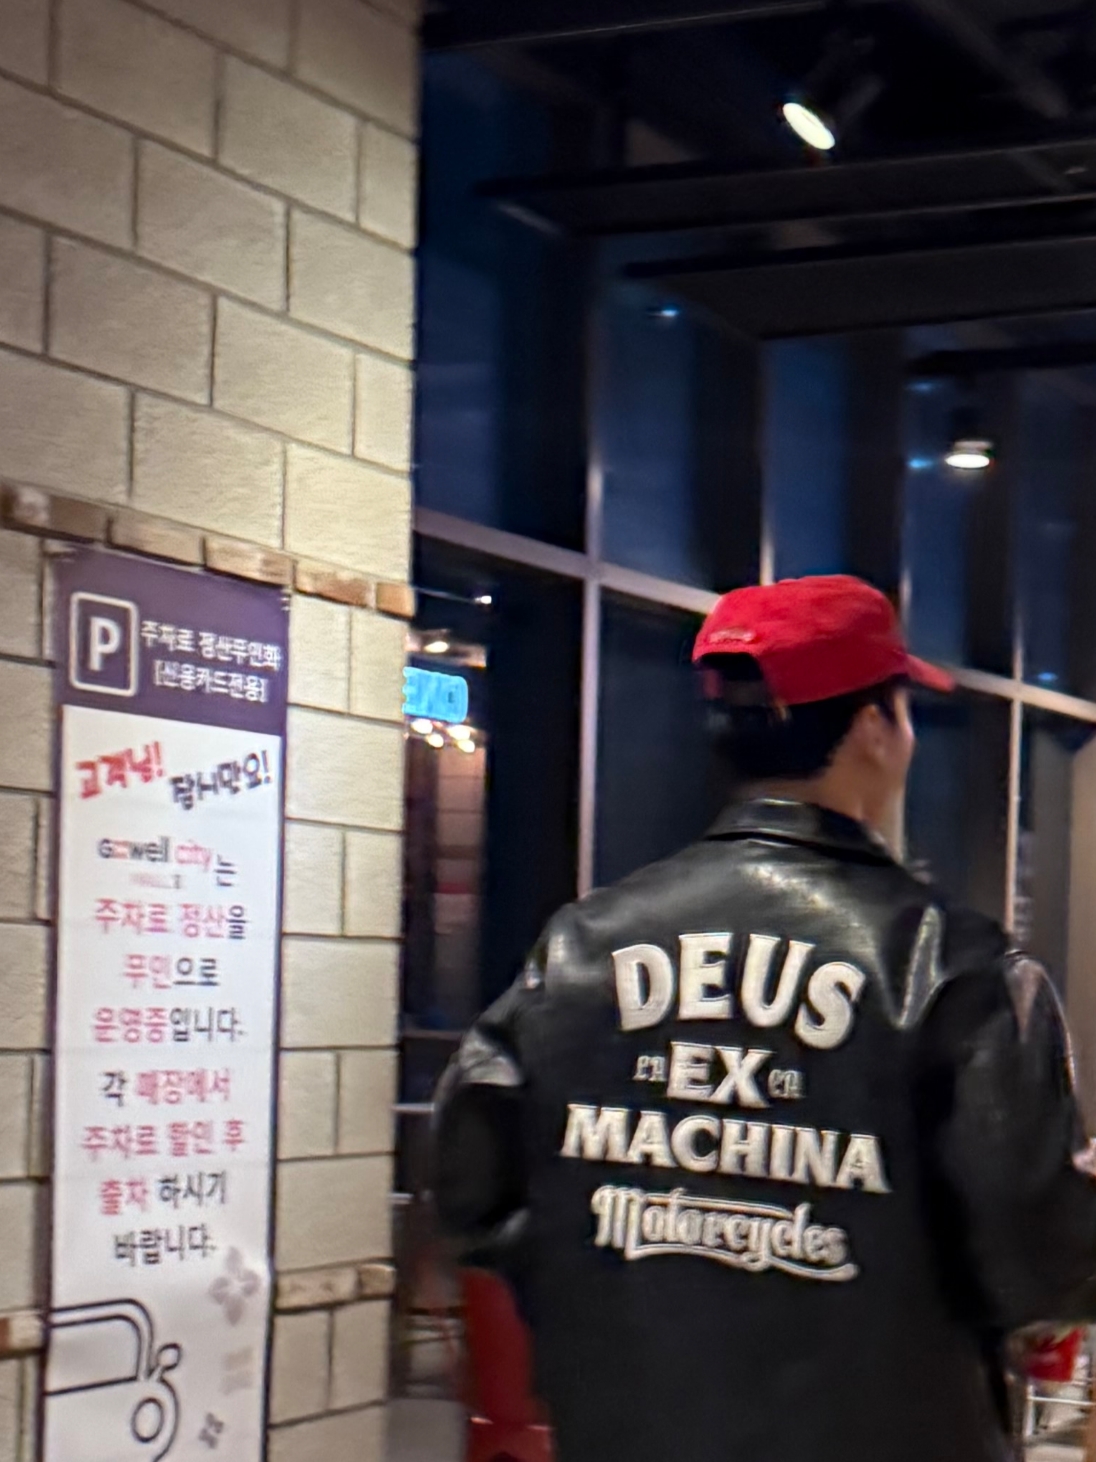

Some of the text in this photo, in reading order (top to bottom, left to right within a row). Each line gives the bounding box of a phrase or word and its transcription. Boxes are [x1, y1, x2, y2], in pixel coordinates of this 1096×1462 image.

[88, 616, 121, 671] P
[178, 903, 250, 940] 정산을
[123, 953, 220, 989] 무인으로
[612, 931, 866, 1049] DEUS
[101, 1070, 127, 1107] 각
[666, 1041, 776, 1109] EX
[560, 1103, 893, 1194] MACHINA
[158, 1171, 227, 1208] 하시기
[591, 1184, 855, 1276] Motorcycles
